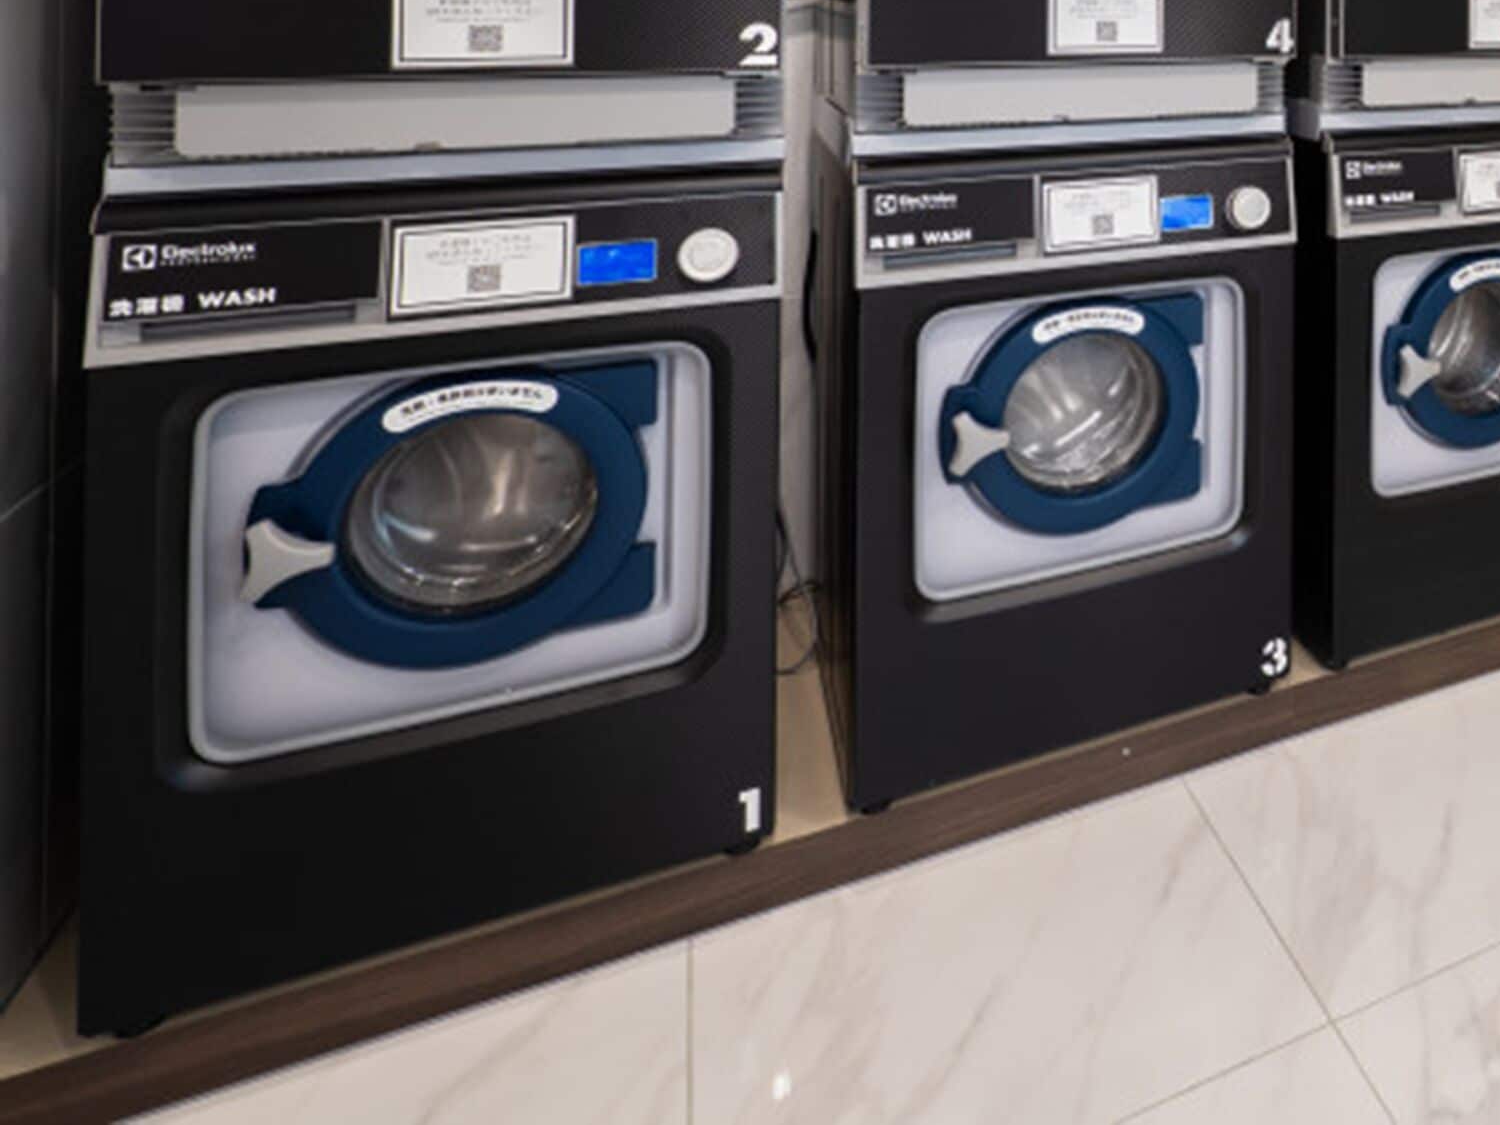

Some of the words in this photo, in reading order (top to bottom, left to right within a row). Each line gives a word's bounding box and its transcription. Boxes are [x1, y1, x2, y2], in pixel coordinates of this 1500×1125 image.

[738, 22, 779, 67] 2
[1265, 17, 1295, 54] 4
[160, 241, 257, 260] Electrolux
[197, 286, 278, 309] WASH
[1261, 636, 1289, 677] 3
[738, 786, 762, 833] 1
